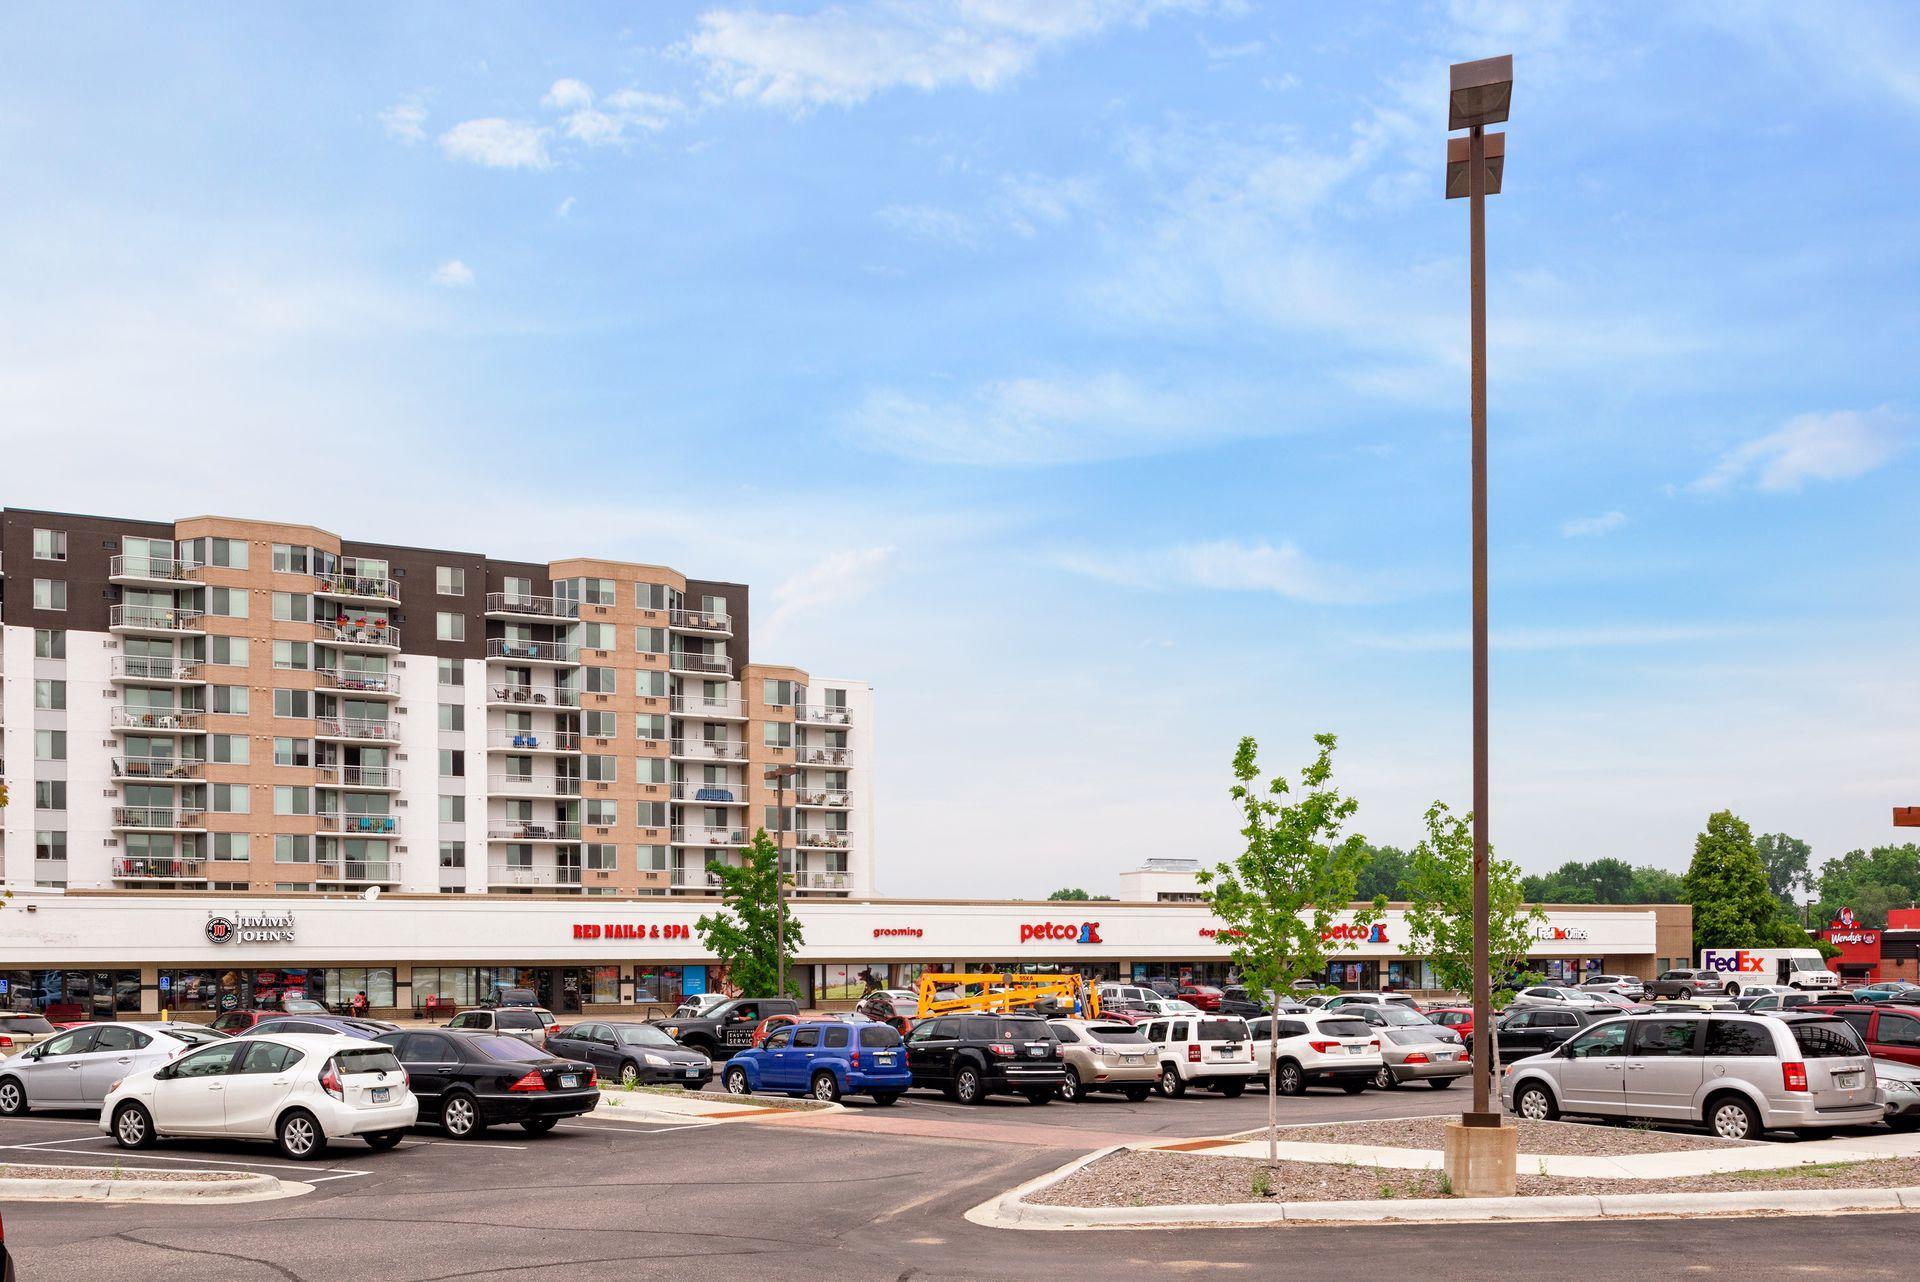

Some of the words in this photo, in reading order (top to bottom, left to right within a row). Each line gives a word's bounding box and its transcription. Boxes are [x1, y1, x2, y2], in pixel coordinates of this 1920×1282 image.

[237, 917, 295, 929] JIMMY
[237, 931, 295, 944] JOHN'S
[573, 925, 601, 939] RED
[604, 925, 646, 939] NAILS
[649, 925, 660, 938] &
[663, 925, 690, 939] SPA
[873, 927, 923, 937] grooming
[1020, 922, 1078, 944] petco
[1199, 928, 1215, 937] dog
[1831, 932, 1862, 944] Wendy's
[1705, 950, 1765, 972] FedEx
